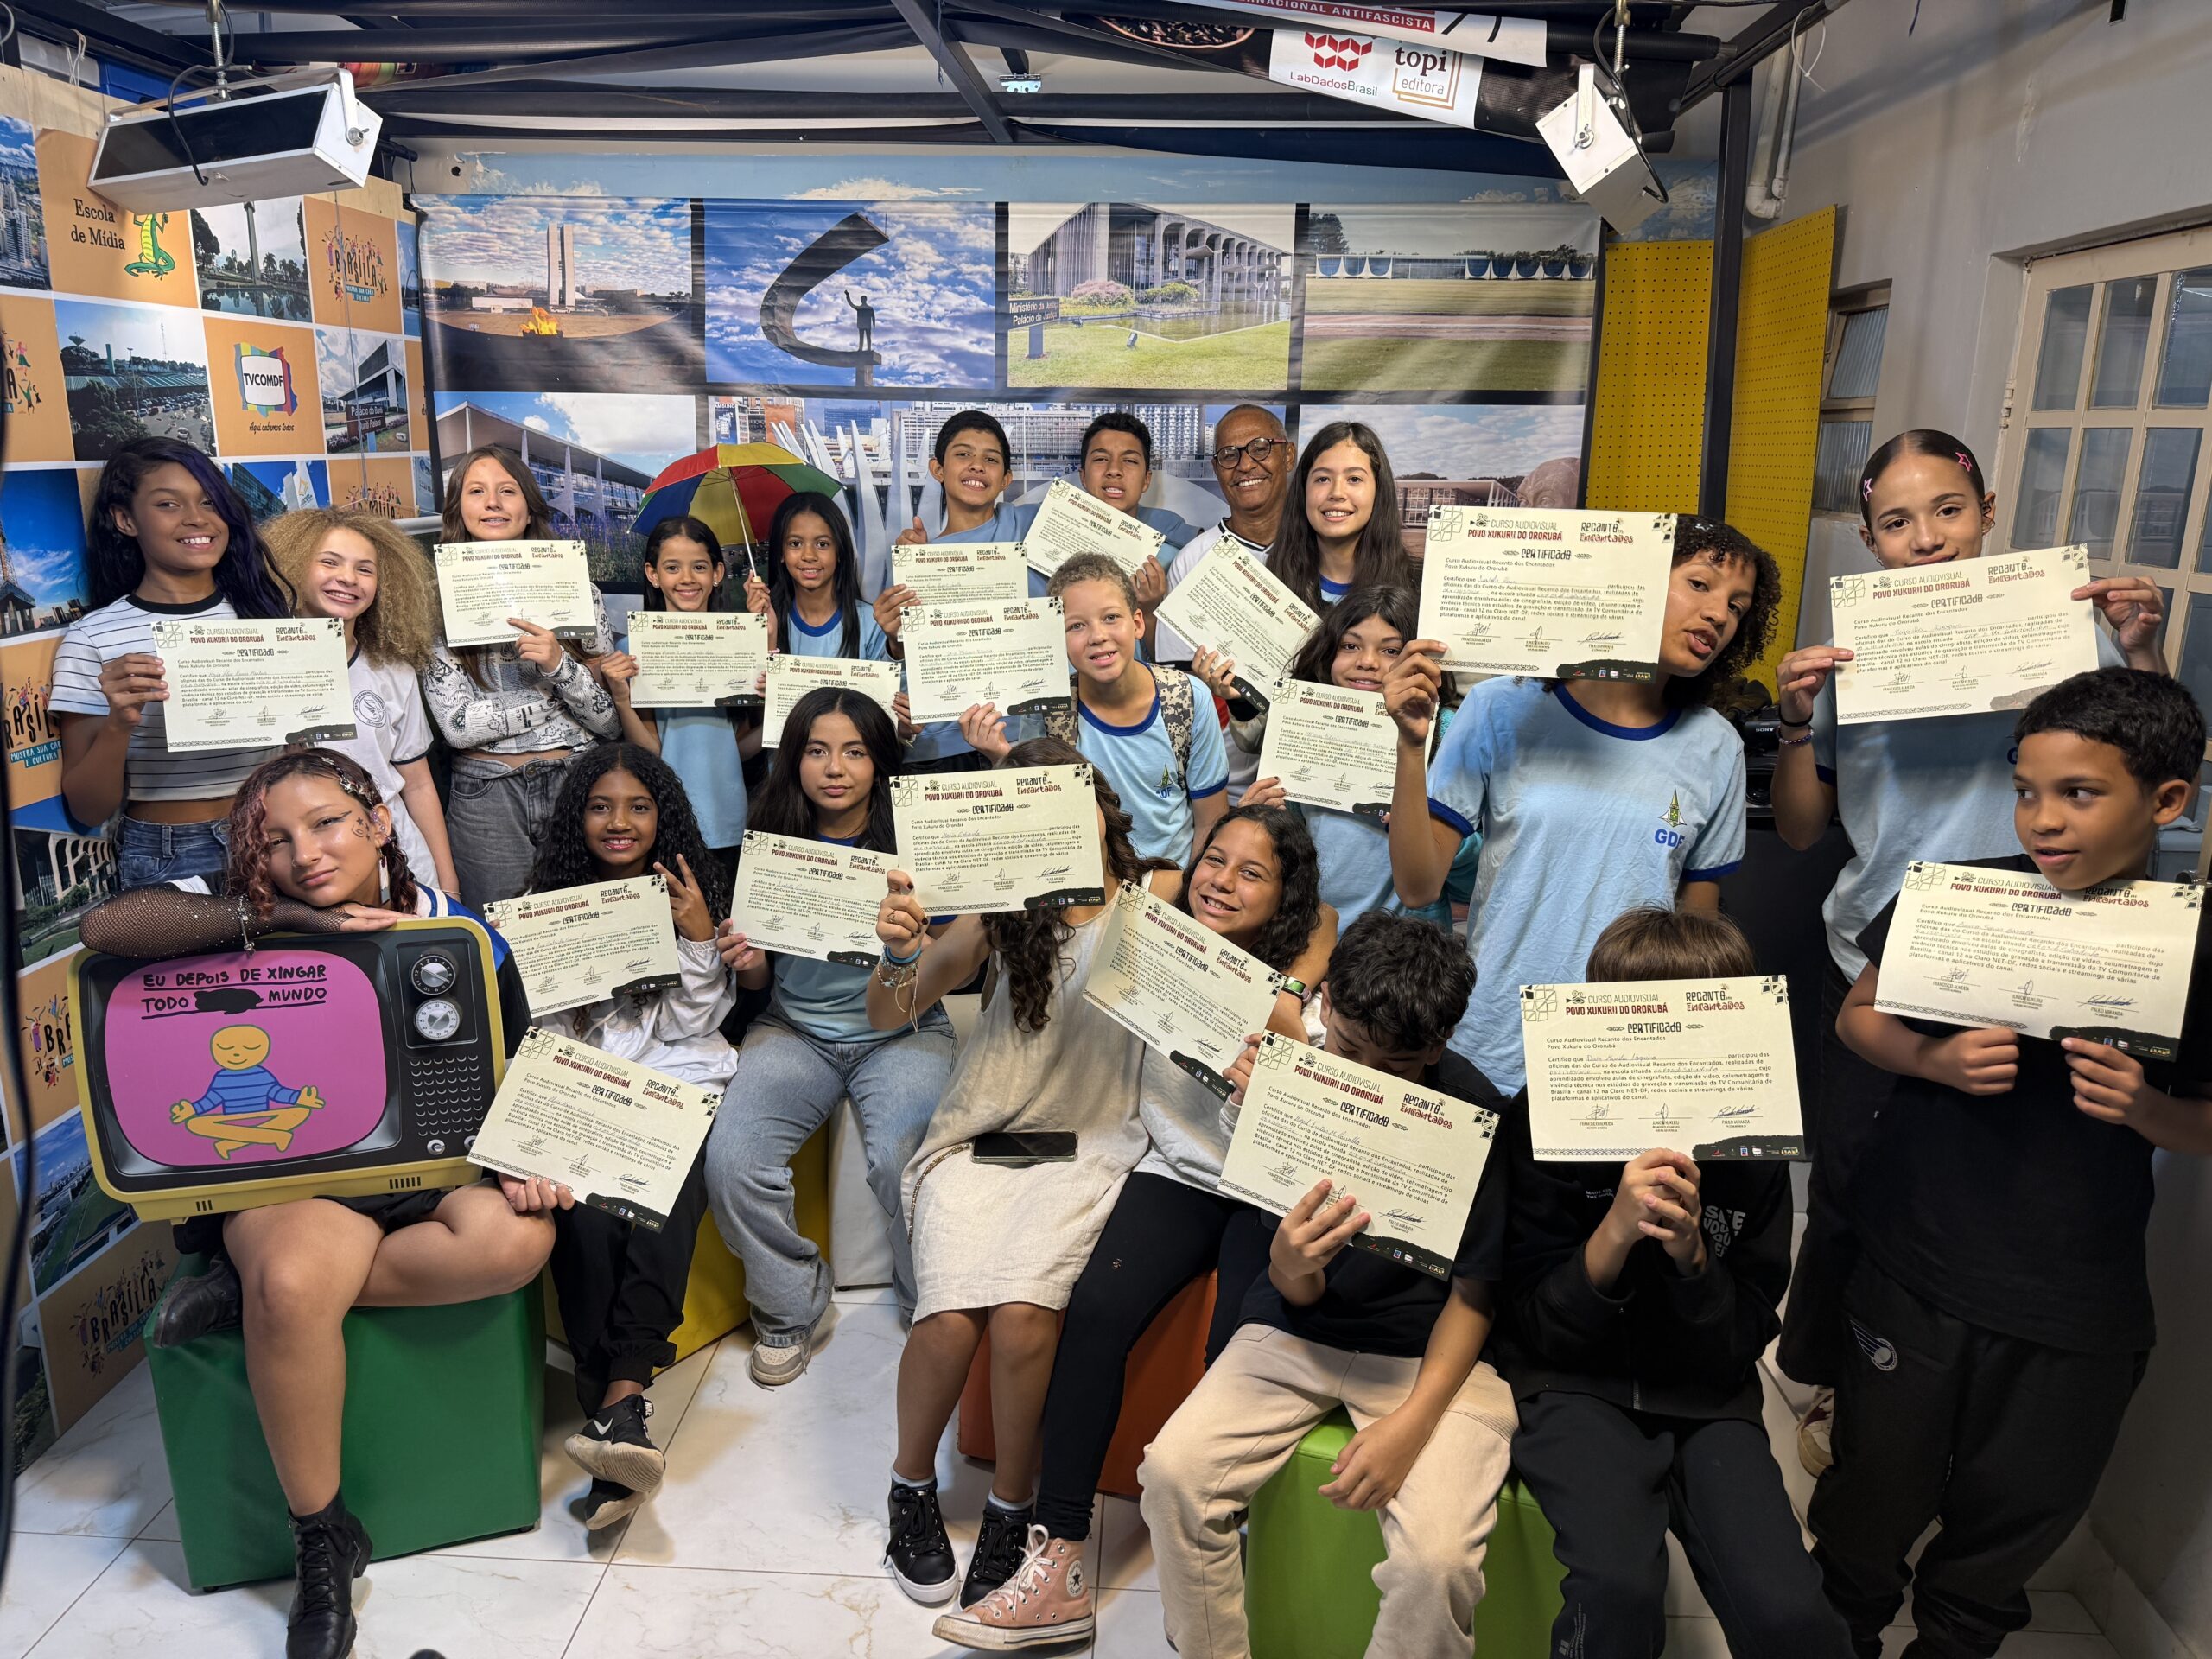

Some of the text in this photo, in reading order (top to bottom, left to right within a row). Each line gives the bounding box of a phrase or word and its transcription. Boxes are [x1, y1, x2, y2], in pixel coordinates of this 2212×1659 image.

[1332, 7, 1431, 29] ANTIFASCISTA
[1395, 47, 1447, 77] topi
[1290, 72, 1378, 96] LabDadosBrasil
[1402, 78, 1445, 96] editora
[73, 198, 115, 223] Escola
[71, 225, 125, 250] de Mídia
[1009, 302, 1038, 314] Ministério
[1014, 314, 1034, 326] Palácio
[244, 372, 283, 388] TVCOMDF
[1872, 589, 1891, 599] POVO
[1923, 583, 1933, 593] DO
[1935, 577, 1970, 591] ORORUBÁ
[1893, 570, 1962, 587] CURSO AUDIOVISUAL
[50, 740, 62, 751] CAR
[940, 783, 960, 791] CURSO
[923, 793, 939, 802] POVO
[1949, 883, 1972, 892] POVO
[2007, 887, 2020, 896] DO
[2021, 887, 2063, 899] ORORUBÁ
[1976, 877, 2056, 890] CURSO AUDIOVISUAL
[143, 964, 327, 987] EU DEPOIS DE XINGAR
[141, 987, 327, 1013] TODO MUNDO
[1565, 1006, 1585, 1015] POVO
[1618, 1005, 1630, 1014] DO
[1630, 1001, 1668, 1014] ORORUBÁ
[1587, 993, 1659, 1003] CURSO AUDIOVISUAL
[553, 1052, 570, 1065] POVO
[593, 1068, 603, 1077] DO
[601, 1070, 632, 1089] ORORUBÁ
[574, 1051, 630, 1077] CURSO AUDIOVISUAL
[1293, 1065, 1312, 1078] POVO
[1339, 1082, 1351, 1093] DO
[1350, 1084, 1385, 1105] ORORUBÁ
[1316, 1062, 1381, 1092] CURSO AUDIOVISUAL
